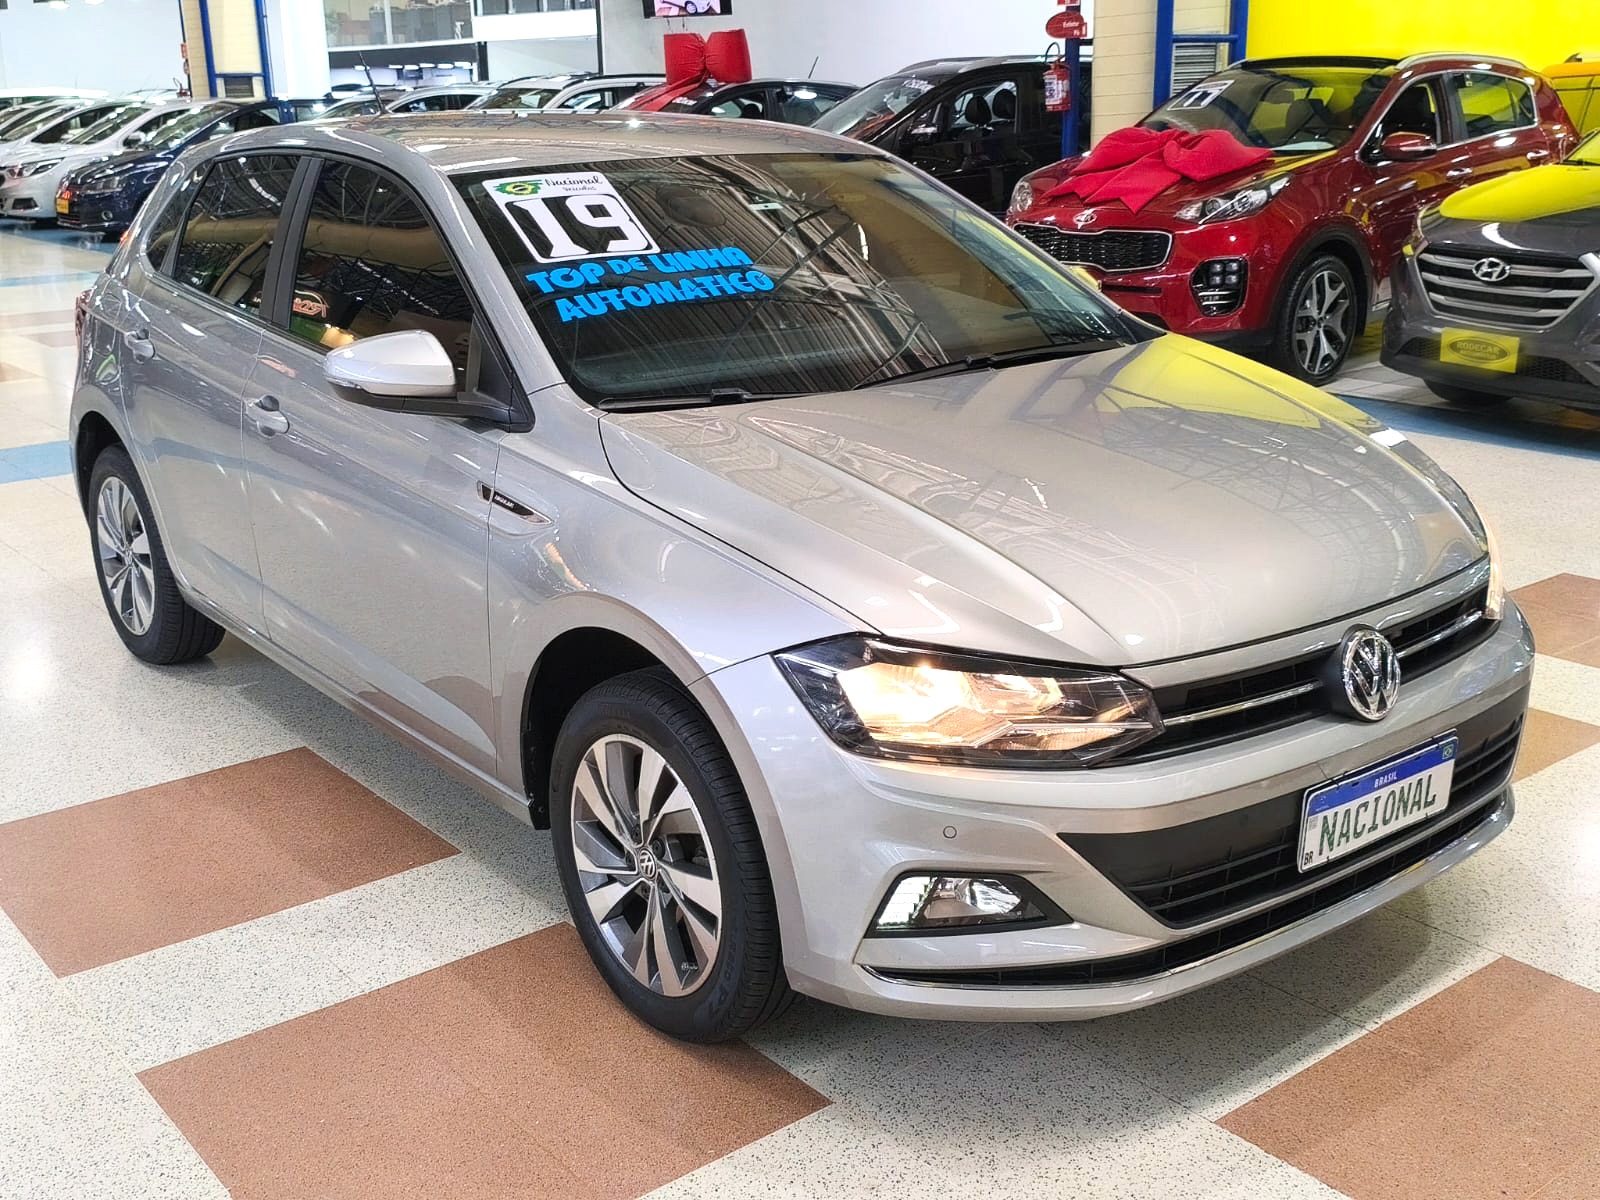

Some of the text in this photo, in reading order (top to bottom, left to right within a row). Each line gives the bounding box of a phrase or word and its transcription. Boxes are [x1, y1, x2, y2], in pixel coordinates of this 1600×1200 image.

[544, 175, 603, 187] Nacional
[512, 194, 652, 259] 19
[525, 246, 754, 295] TOP DE LINHA
[1456, 340, 1500, 356] RODECAR
[1373, 771, 1398, 789] BRASIL
[1318, 773, 1437, 857] NACIONAL
[1303, 850, 1314, 867] BR
